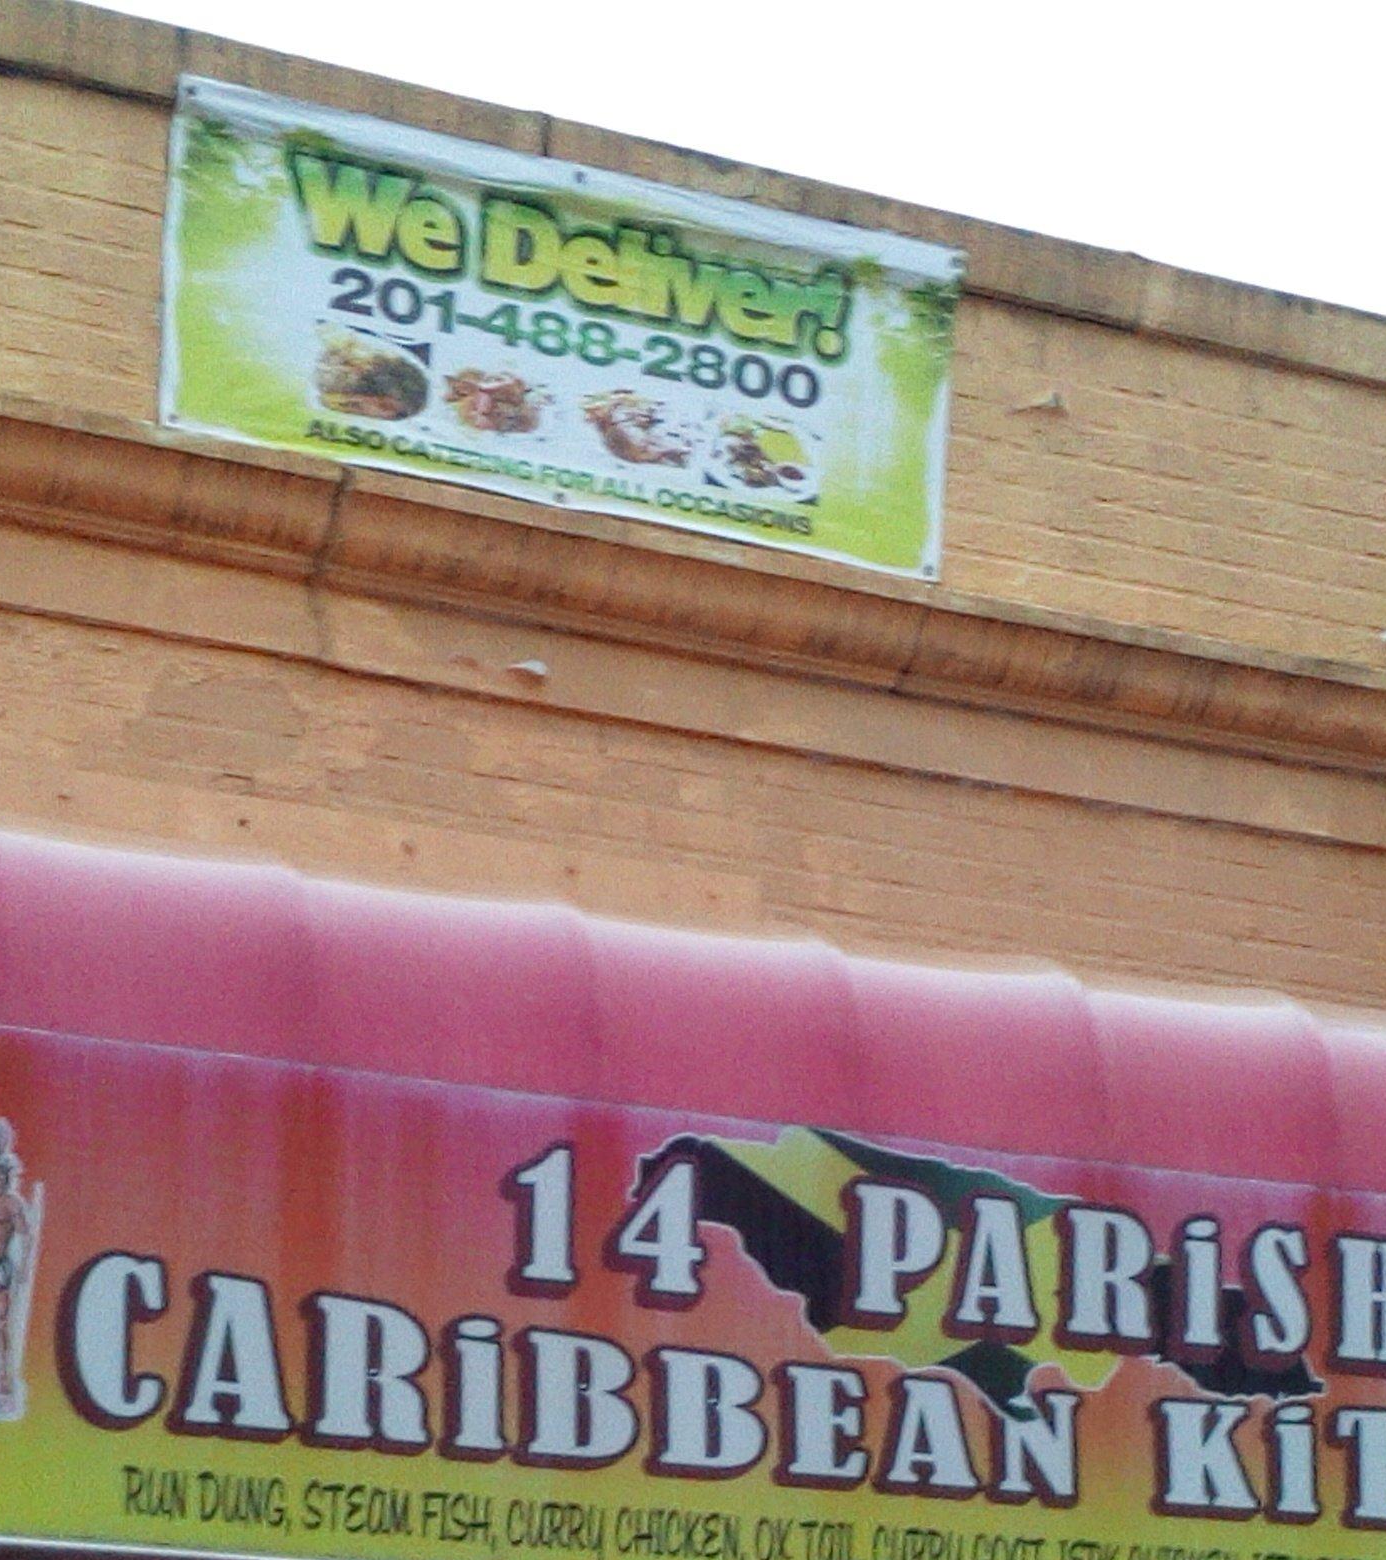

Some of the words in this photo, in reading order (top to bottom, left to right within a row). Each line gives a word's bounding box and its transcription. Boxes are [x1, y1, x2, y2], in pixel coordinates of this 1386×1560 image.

[287, 147, 464, 281] We
[482, 194, 852, 364] Deliver!
[329, 266, 821, 408] 201-488-2800
[311, 418, 387, 450] ALSO
[536, 463, 594, 492] FOR
[598, 474, 650, 504] ALL
[655, 486, 812, 535] OCCASIONS
[508, 1142, 707, 1309] 14
[59, 1250, 1081, 1508] CARiBBEAN
[121, 1465, 187, 1521] RUN
